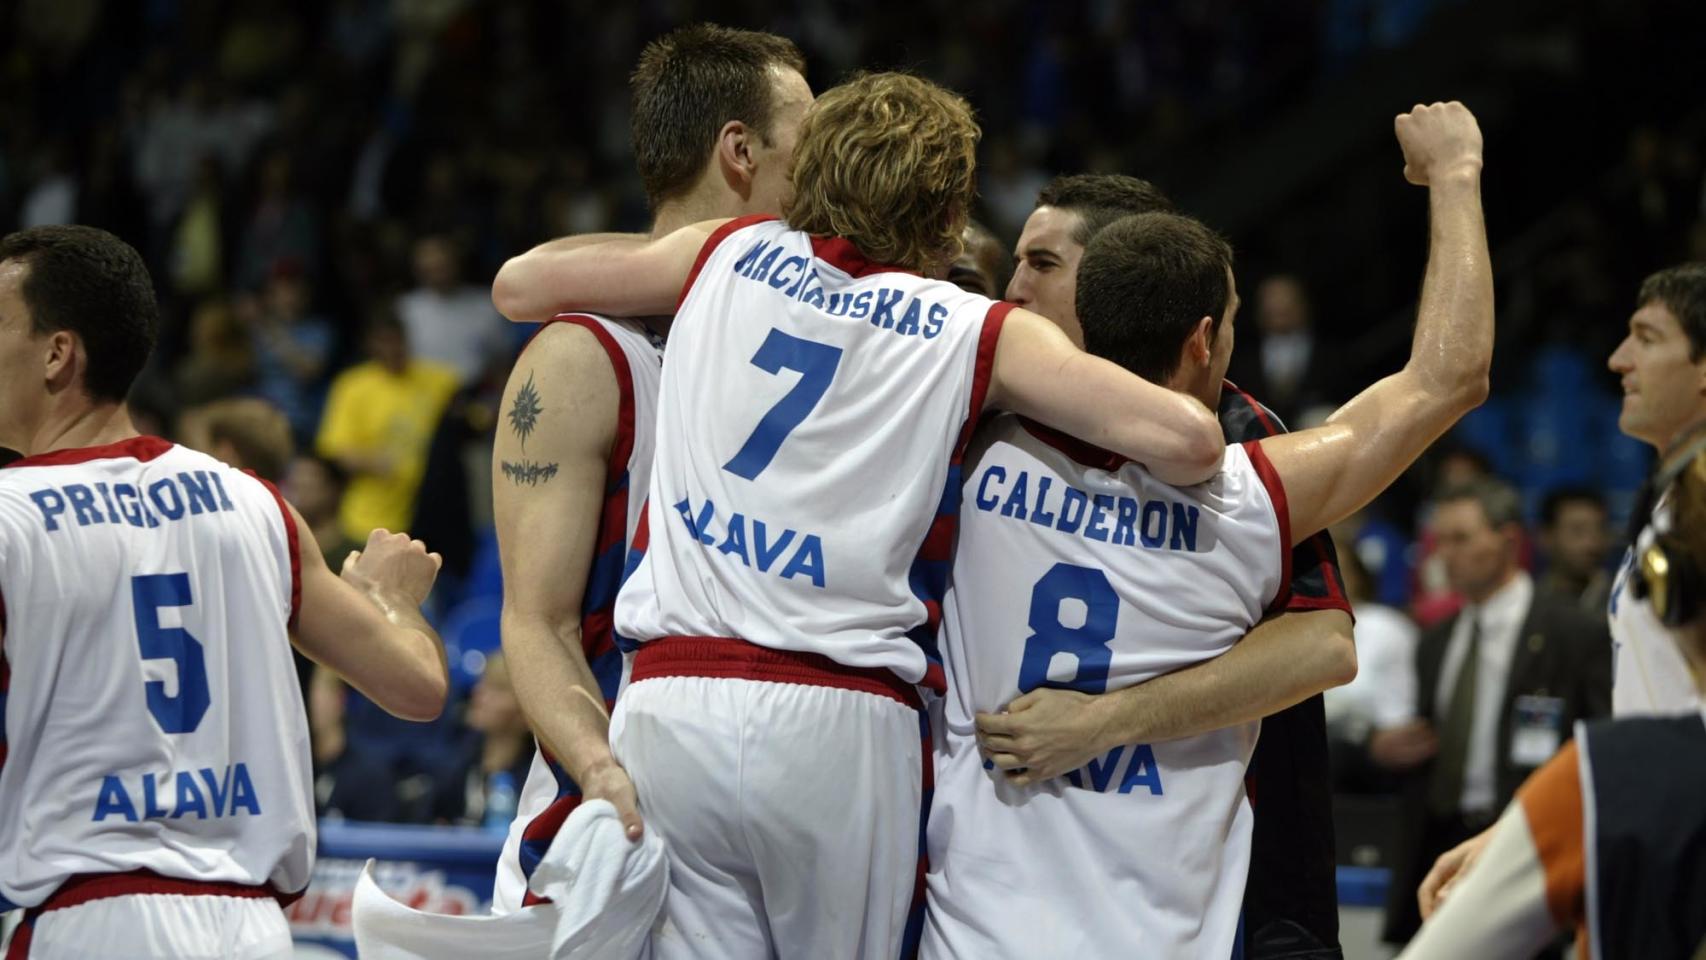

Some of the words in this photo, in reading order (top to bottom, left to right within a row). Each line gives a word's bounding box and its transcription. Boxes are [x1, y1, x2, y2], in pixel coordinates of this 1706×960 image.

[722, 327, 844, 482] 7
[975, 465, 1199, 552] CALDERON
[131, 572, 211, 734] 5
[1018, 562, 1120, 694] 8
[92, 763, 262, 822] ALAVA
